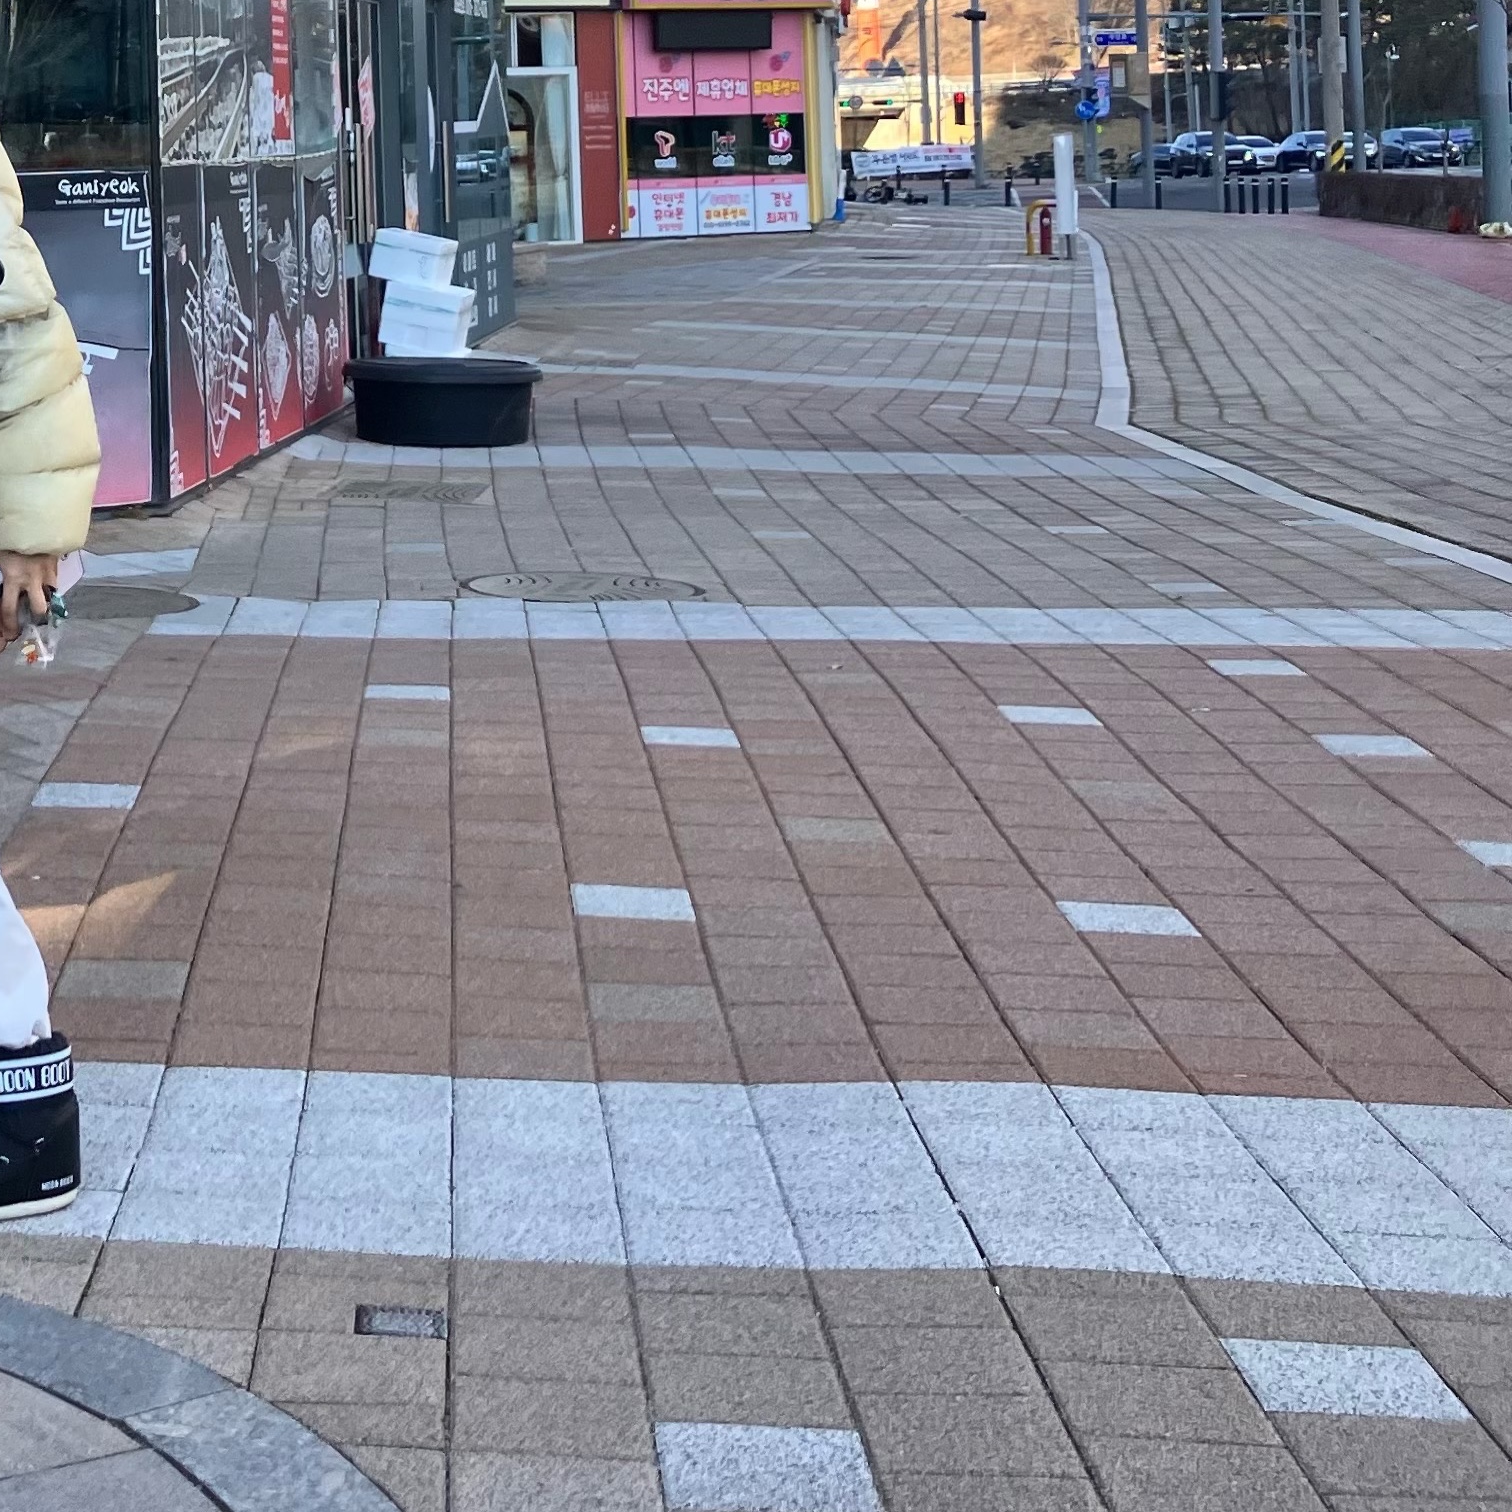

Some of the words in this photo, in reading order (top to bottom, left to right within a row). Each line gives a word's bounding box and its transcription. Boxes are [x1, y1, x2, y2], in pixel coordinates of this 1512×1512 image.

[58, 176, 140, 197] Ganiyeok
[651, 191, 685, 206] 인터넷
[41, 1057, 72, 1088] BOOT
